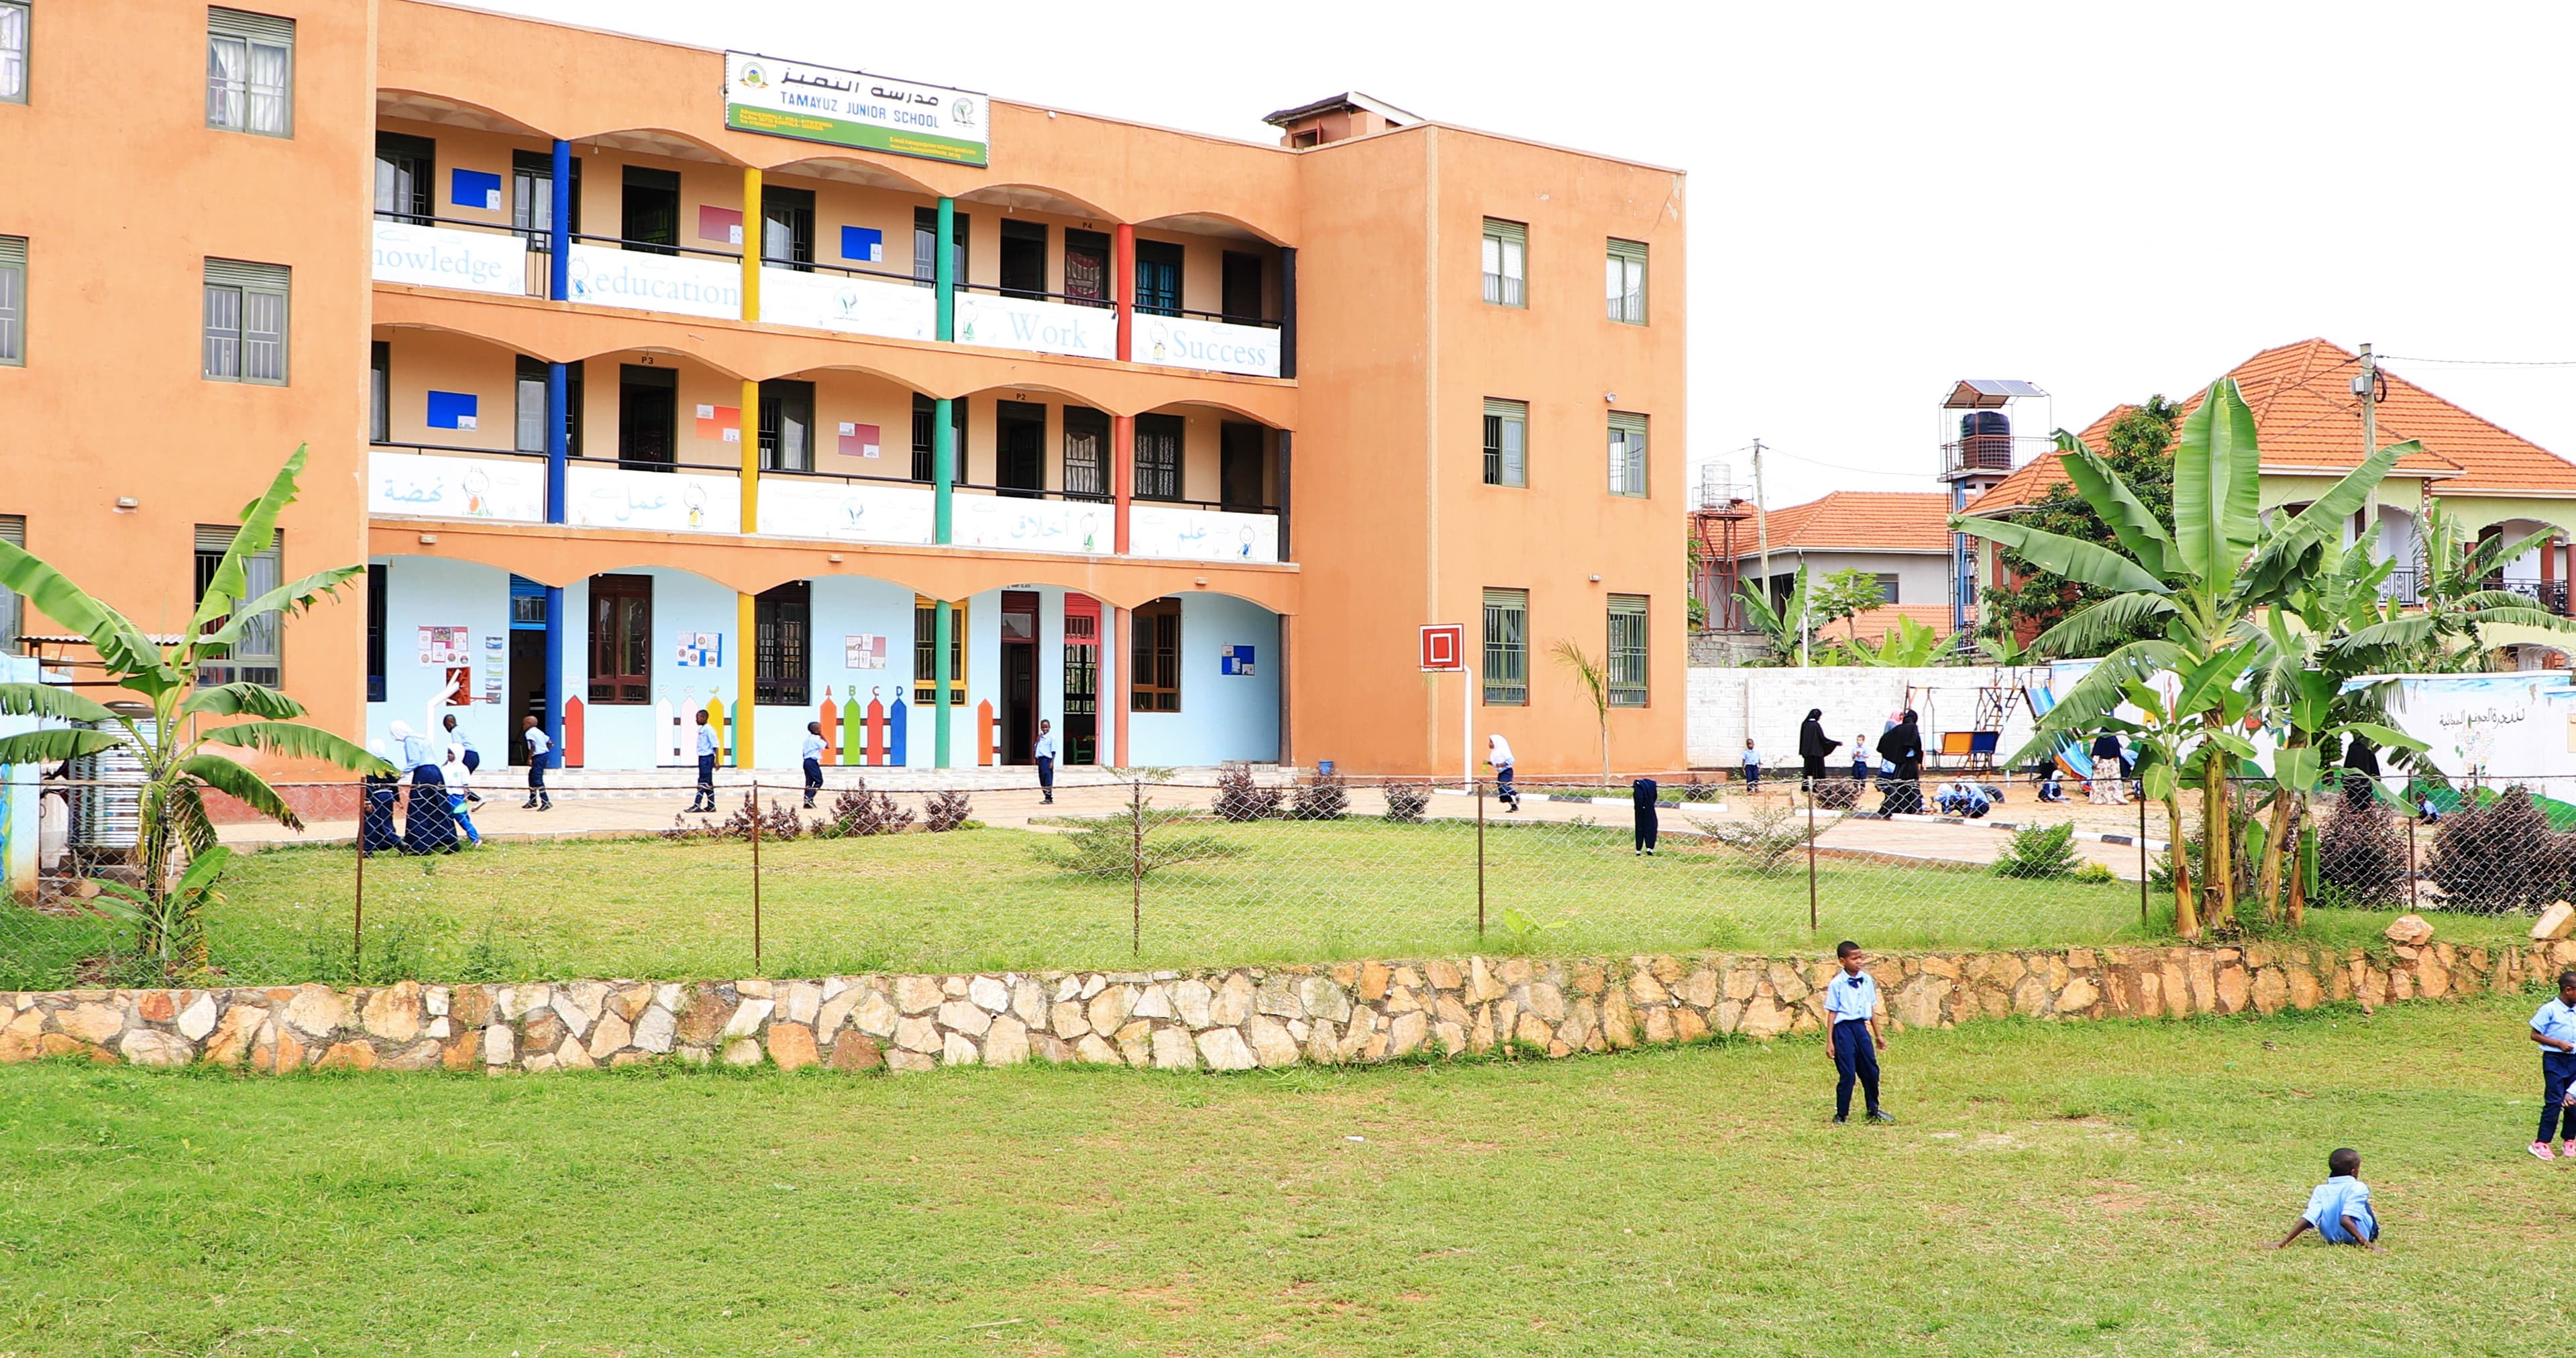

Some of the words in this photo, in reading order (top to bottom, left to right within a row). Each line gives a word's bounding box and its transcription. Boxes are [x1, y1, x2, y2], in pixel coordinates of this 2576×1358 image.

[780, 91, 838, 112] TAMAYUZ
[847, 102, 886, 119] JUNIOR
[894, 110, 939, 129] SCHOOL
[1082, 221, 1093, 230] P4
[372, 245, 502, 285] nowledge
[596, 266, 738, 306] education
[1008, 311, 1088, 349] Work
[1173, 329, 1267, 367] Success
[641, 356, 654, 365] P3
[1016, 393, 1026, 401] P2
[614, 483, 667, 522] عمل
[825, 685, 832, 696] A
[848, 685, 856, 696] B
[872, 685, 879, 696] C
[896, 685, 903, 697] D
